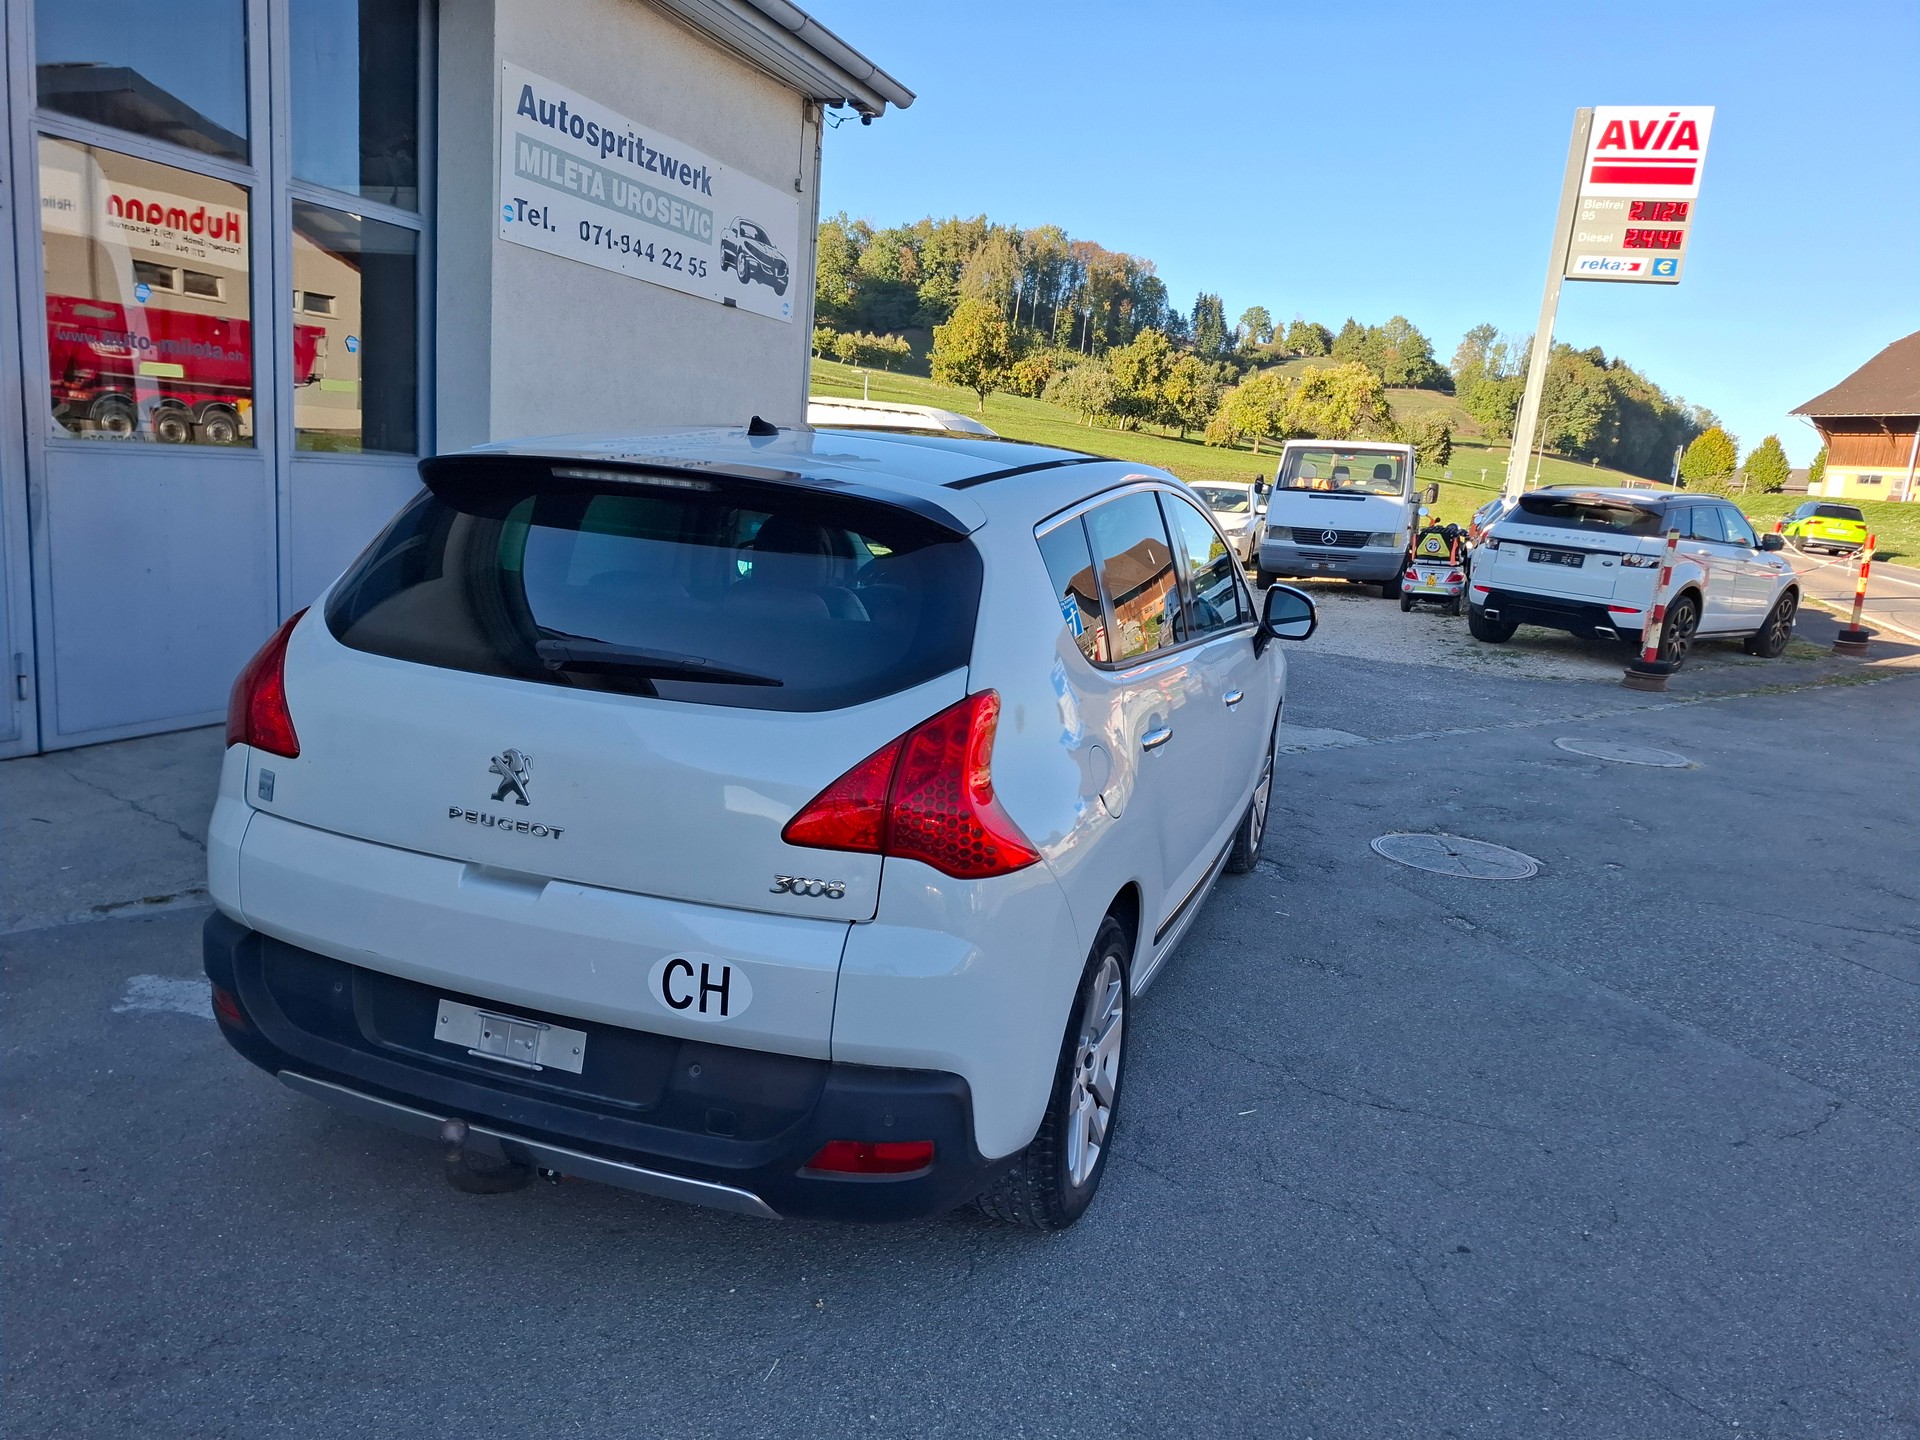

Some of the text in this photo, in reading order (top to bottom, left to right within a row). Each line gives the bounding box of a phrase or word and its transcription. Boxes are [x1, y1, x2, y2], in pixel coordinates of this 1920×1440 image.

[517, 84, 713, 197] Autospritzwerk
[1596, 112, 1700, 151] AVIA
[519, 141, 712, 239] MILETA UROSEVIC
[1583, 199, 1625, 210] Bleifrei
[1582, 211, 1596, 221] 95
[513, 197, 556, 232] Tel.
[662, 248, 683, 271] 22
[688, 257, 707, 278] 55
[1578, 232, 1613, 243] Diesel
[449, 806, 565, 840] PEUGEOT
[769, 873, 846, 900] 3008
[662, 958, 731, 1016] CH
